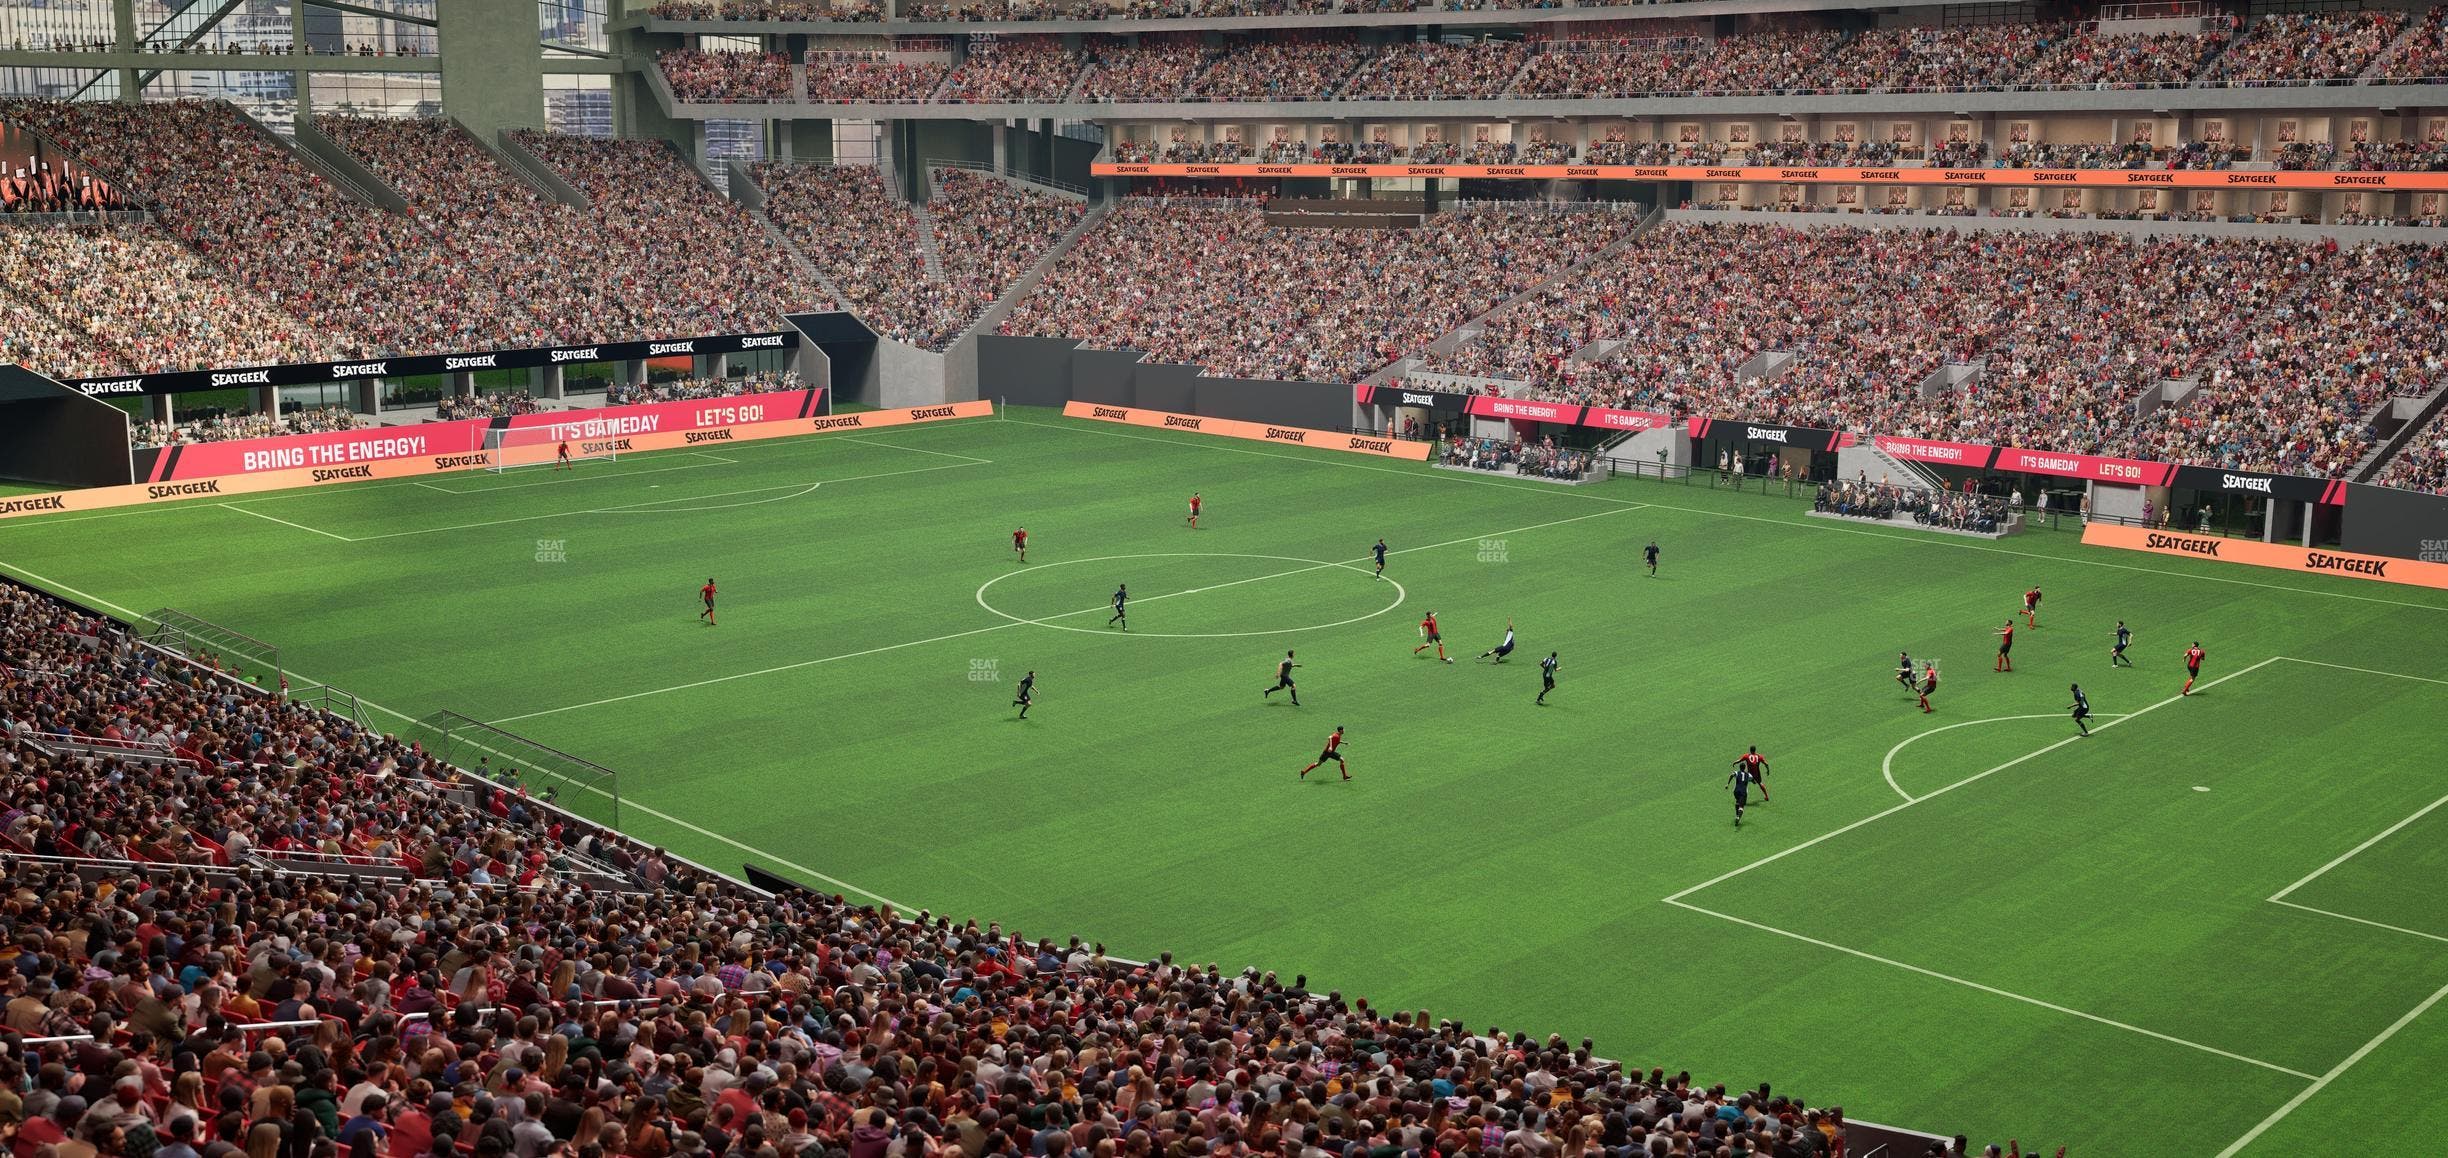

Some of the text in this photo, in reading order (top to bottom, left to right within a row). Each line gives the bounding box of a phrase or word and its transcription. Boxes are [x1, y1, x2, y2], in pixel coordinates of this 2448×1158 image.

[1117, 165, 1149, 173] SEATGEEK
[1186, 166, 1220, 174] SEATGEEK
[1258, 166, 1292, 174] SEATGEEK
[1332, 167, 1367, 175] SEATGEEK
[1408, 167, 1445, 175] SEATGEEK
[1487, 168, 1524, 176] SEATGEEK
[1567, 168, 1599, 176] SEATGEEK
[1635, 169, 1668, 177] SEATGEEK
[1706, 170, 1741, 178] SEATGEEK
[1782, 170, 1818, 179] SEATGEEK
[1861, 171, 1900, 180] SEATGEEK
[1945, 172, 1986, 181] SEATGEEK
[2034, 172, 2077, 182] SEATGEEK
[2128, 173, 2173, 183] SEATGEEK
[2228, 174, 2276, 184] SEATGEEK
[2334, 175, 2386, 185] SEATGEEK
[649, 341, 694, 355] SEATGEEK
[742, 335, 783, 348] SEATGEEK
[551, 347, 598, 362] SEATGEEK
[332, 362, 387, 377] SEATGEEK
[446, 355, 496, 370] SEATGEEK
[211, 370, 270, 387] SEATGEEK
[81, 379, 143, 395] SEATGEEK
[1402, 392, 1433, 407] SEATGEEK
[696, 405, 764, 426] LET'S GO!
[911, 406, 955, 420] SEATGEEK
[1093, 406, 1128, 420] SEATGEEK
[1494, 403, 1557, 418] BRING THE ENERGY!
[585, 414, 659, 437] GAMEDAY
[815, 416, 862, 430] SEATGEEK
[1164, 415, 1202, 430] SEATGEEK
[1619, 416, 1654, 428] GAMEDA
[685, 428, 733, 444] SEATGEEK
[1265, 427, 1306, 442] SEATGEEK
[1747, 427, 1788, 443] SEATGEEK
[582, 439, 632, 454] SEATGEEK
[1349, 437, 1392, 453] SEATGEEK
[1912, 445, 1927, 456] THE
[1928, 446, 1962, 460] ENERGY!
[243, 436, 427, 471] BRING THE ENERGY!
[435, 453, 490, 469] SEATGEEK
[2020, 456, 2079, 472] IT'S GAMEDAY
[2099, 463, 2141, 478] LET'S GO!
[312, 464, 373, 482] SEATGEEK
[148, 480, 220, 499] SEATGEEK
[2223, 474, 2272, 493] SEATGEEK
[0, 495, 65, 513] EATGEEK
[2146, 533, 2221, 557] SEATGEEK
[2306, 552, 2389, 578] SEATGEEK
[1749, 755, 1759, 763] 01
